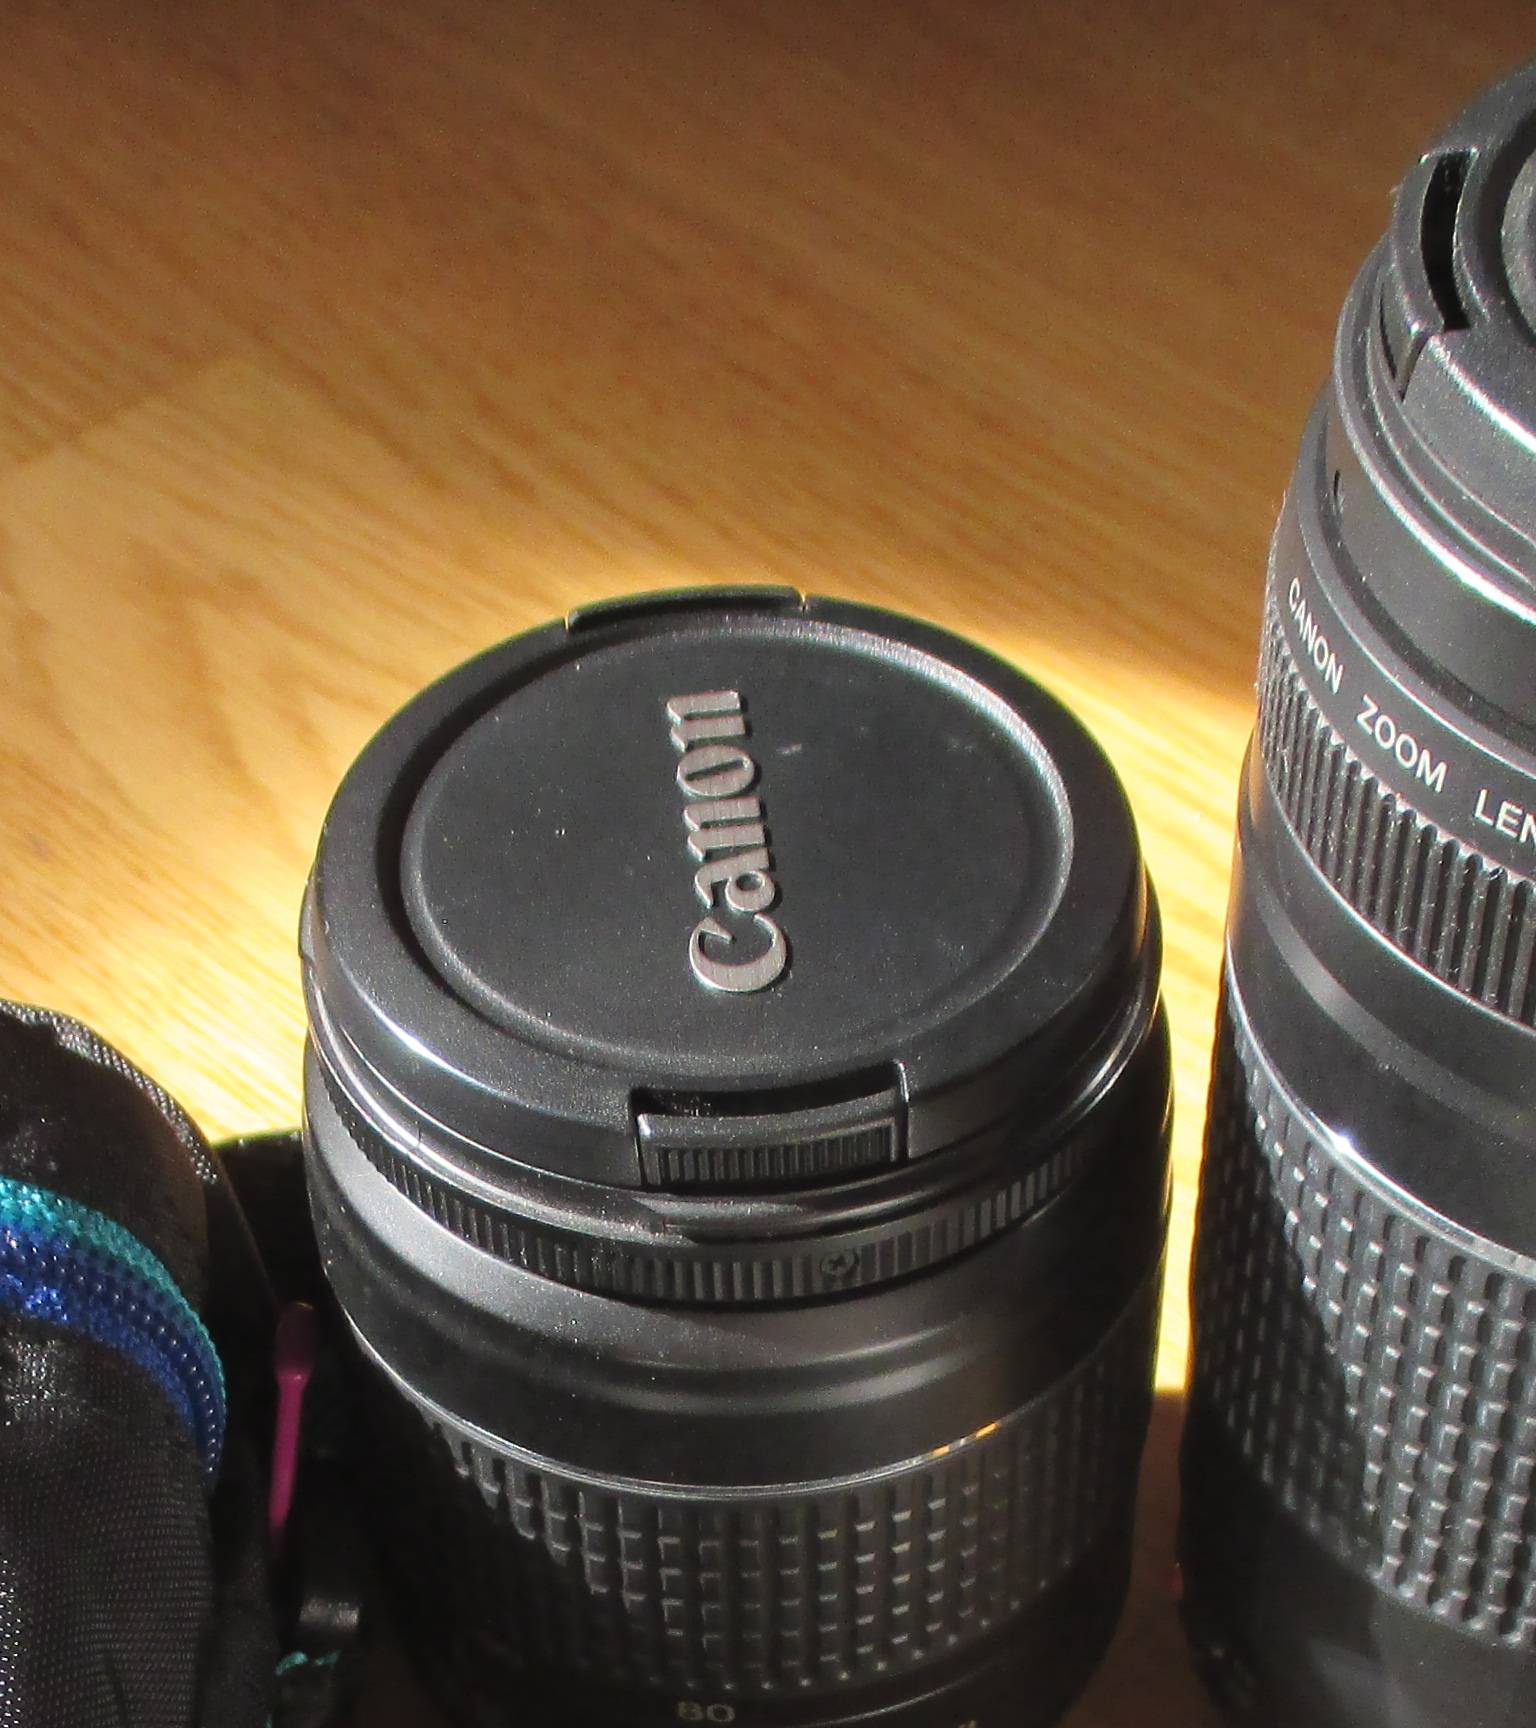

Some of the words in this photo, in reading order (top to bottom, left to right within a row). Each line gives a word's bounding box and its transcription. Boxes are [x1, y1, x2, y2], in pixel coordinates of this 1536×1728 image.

[1287, 576, 1345, 695] CANON
[1355, 693, 1448, 793] ZOOM
[666, 688, 789, 994] Canon
[675, 1700, 737, 1724] 80
